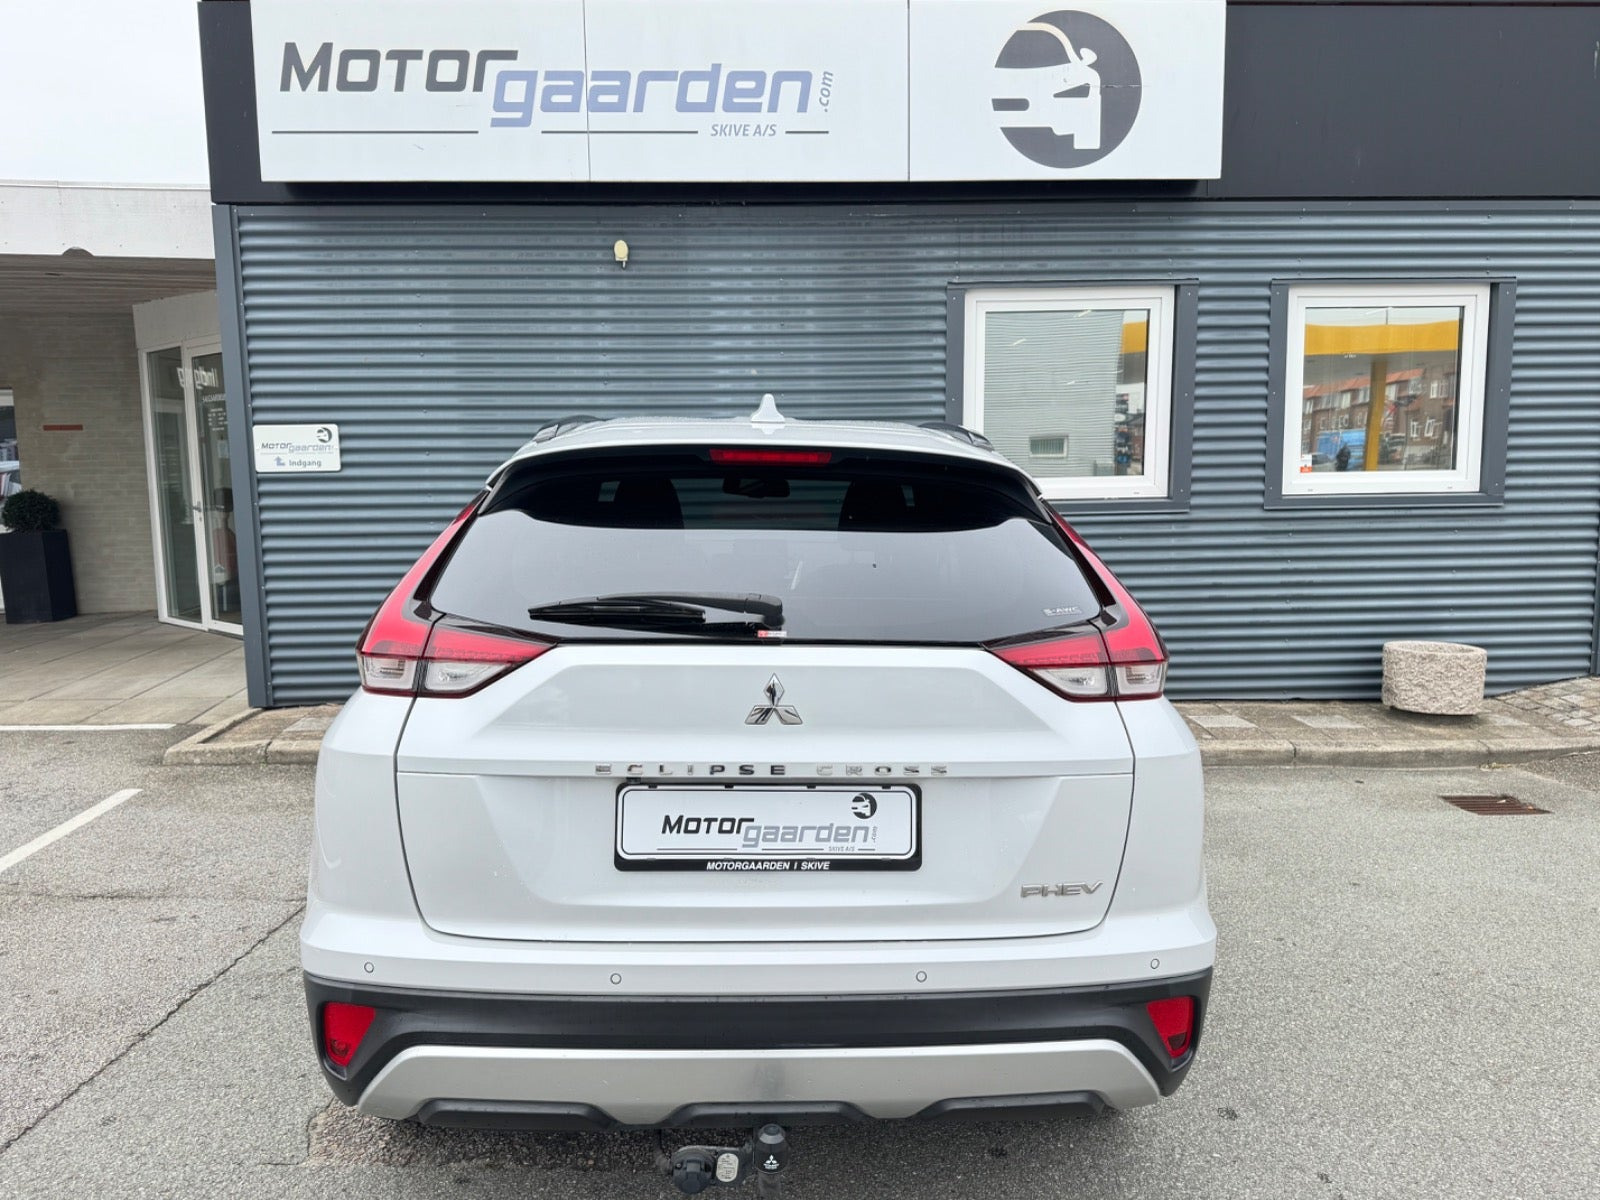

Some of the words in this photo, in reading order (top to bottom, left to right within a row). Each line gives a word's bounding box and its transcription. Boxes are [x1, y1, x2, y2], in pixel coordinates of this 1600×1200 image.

[818, 70, 834, 113] .com
[710, 123, 750, 137] SKIVE
[752, 123, 777, 137] A/S
[288, 459, 322, 468] Indgang
[595, 763, 786, 775] ECLIPSE
[816, 764, 948, 776] CROSS
[706, 860, 790, 870] MOTORGAARDEN
[800, 860, 830, 870] SKIVE
[1020, 881, 1104, 898] PHEV
